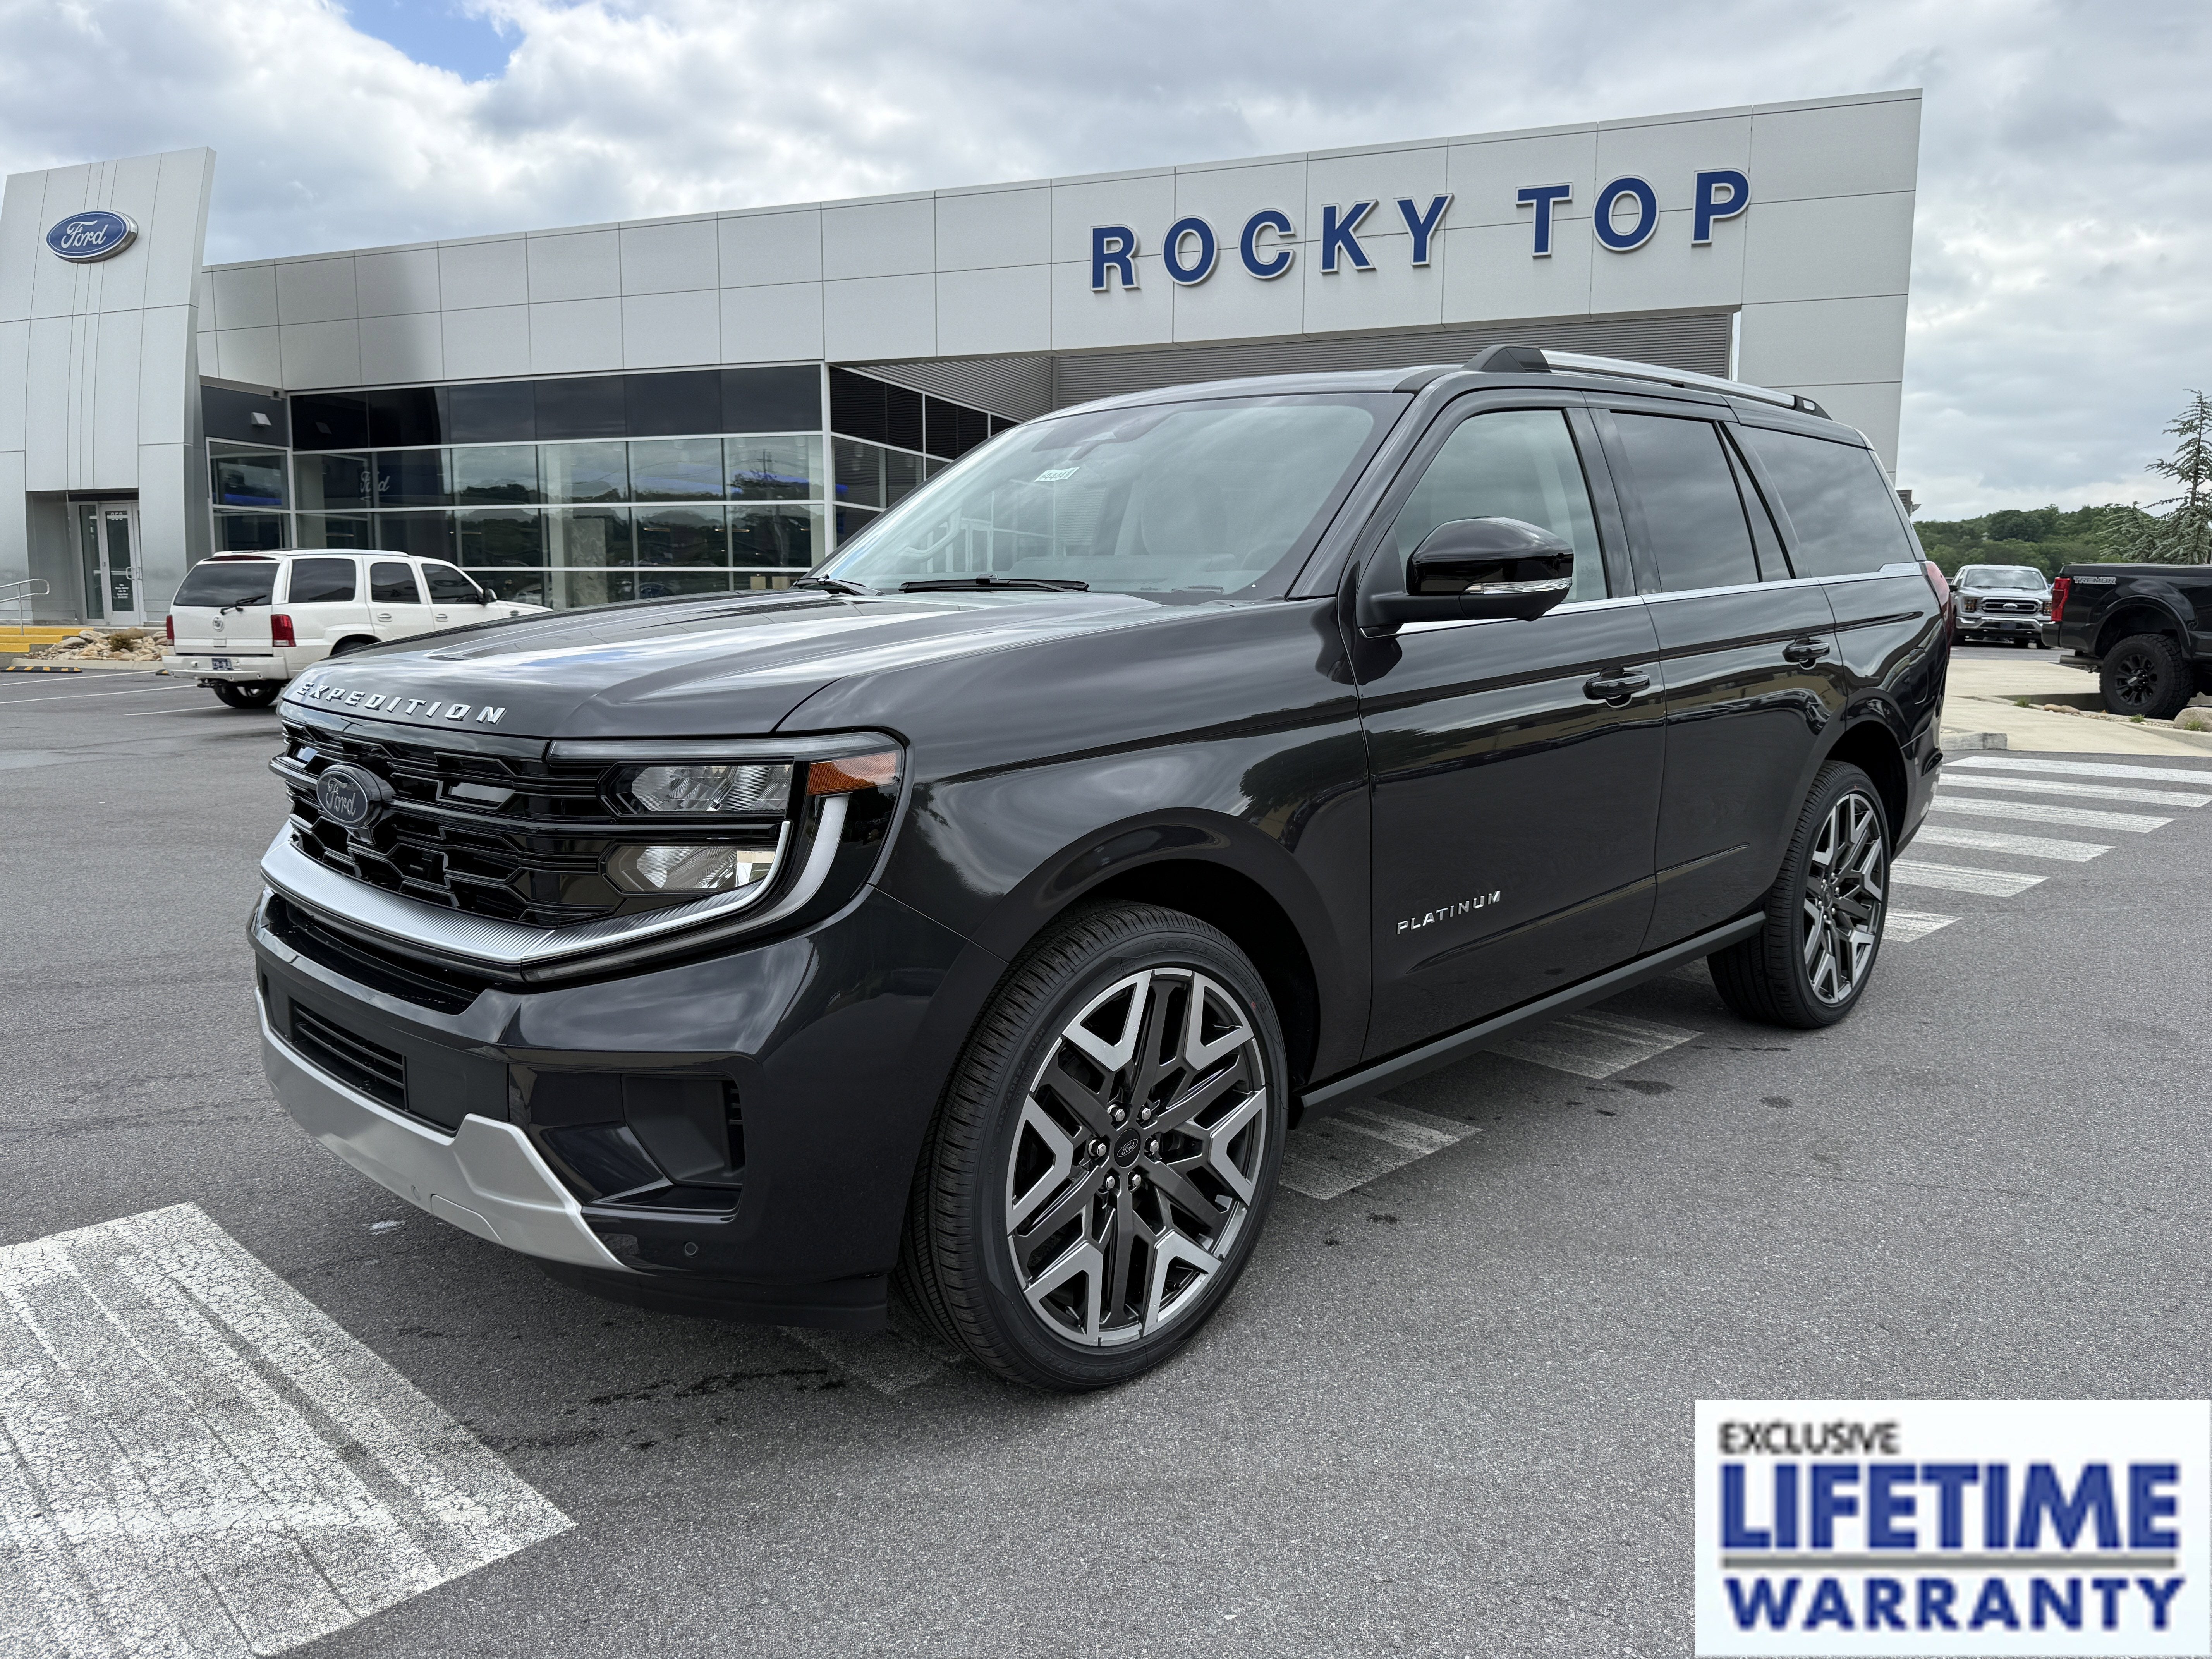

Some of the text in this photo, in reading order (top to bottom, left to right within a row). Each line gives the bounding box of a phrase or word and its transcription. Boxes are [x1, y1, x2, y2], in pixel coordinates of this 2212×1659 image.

[61, 220, 109, 249] Ford
[1091, 169, 1750, 290] ROCKY TOP
[360, 471, 390, 493] Fod
[2073, 576, 2116, 585] TREMOR
[297, 682, 506, 725] EXPEDITION
[326, 777, 356, 816] Ford
[1396, 890, 1501, 935] PLATINUM
[1151, 940, 1210, 955] EAGLE
[1121, 1141, 1135, 1155] Ford
[1023, 1336, 1138, 1376] GOODYEAR
